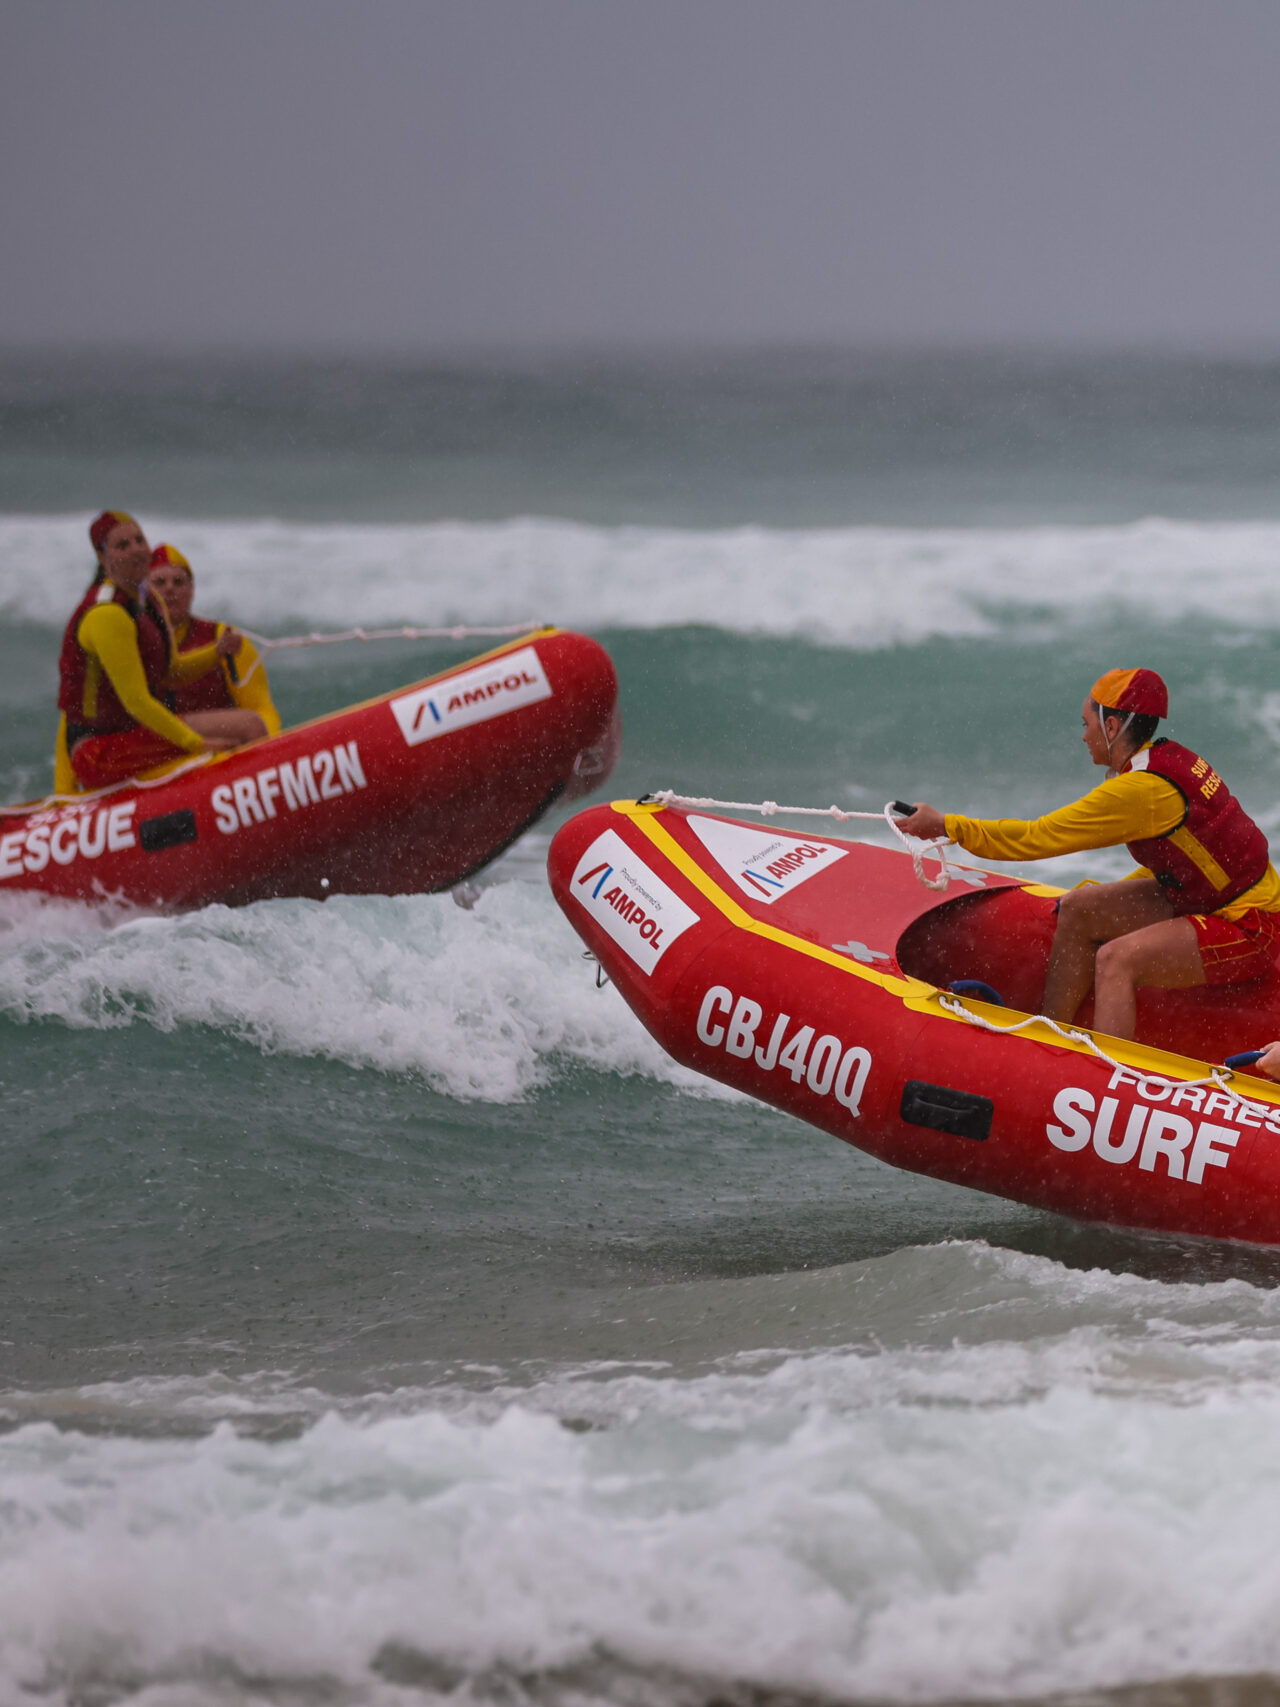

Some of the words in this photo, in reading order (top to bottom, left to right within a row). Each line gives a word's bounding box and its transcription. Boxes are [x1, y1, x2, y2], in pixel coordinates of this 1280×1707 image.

[447, 671, 538, 714] AMPOL
[210, 741, 367, 835] SRFM2N
[765, 843, 828, 880] AMPOL
[603, 886, 664, 951] AMPOL
[696, 985, 872, 1119] CBJ40Q
[1046, 1087, 1241, 1185] SURF
